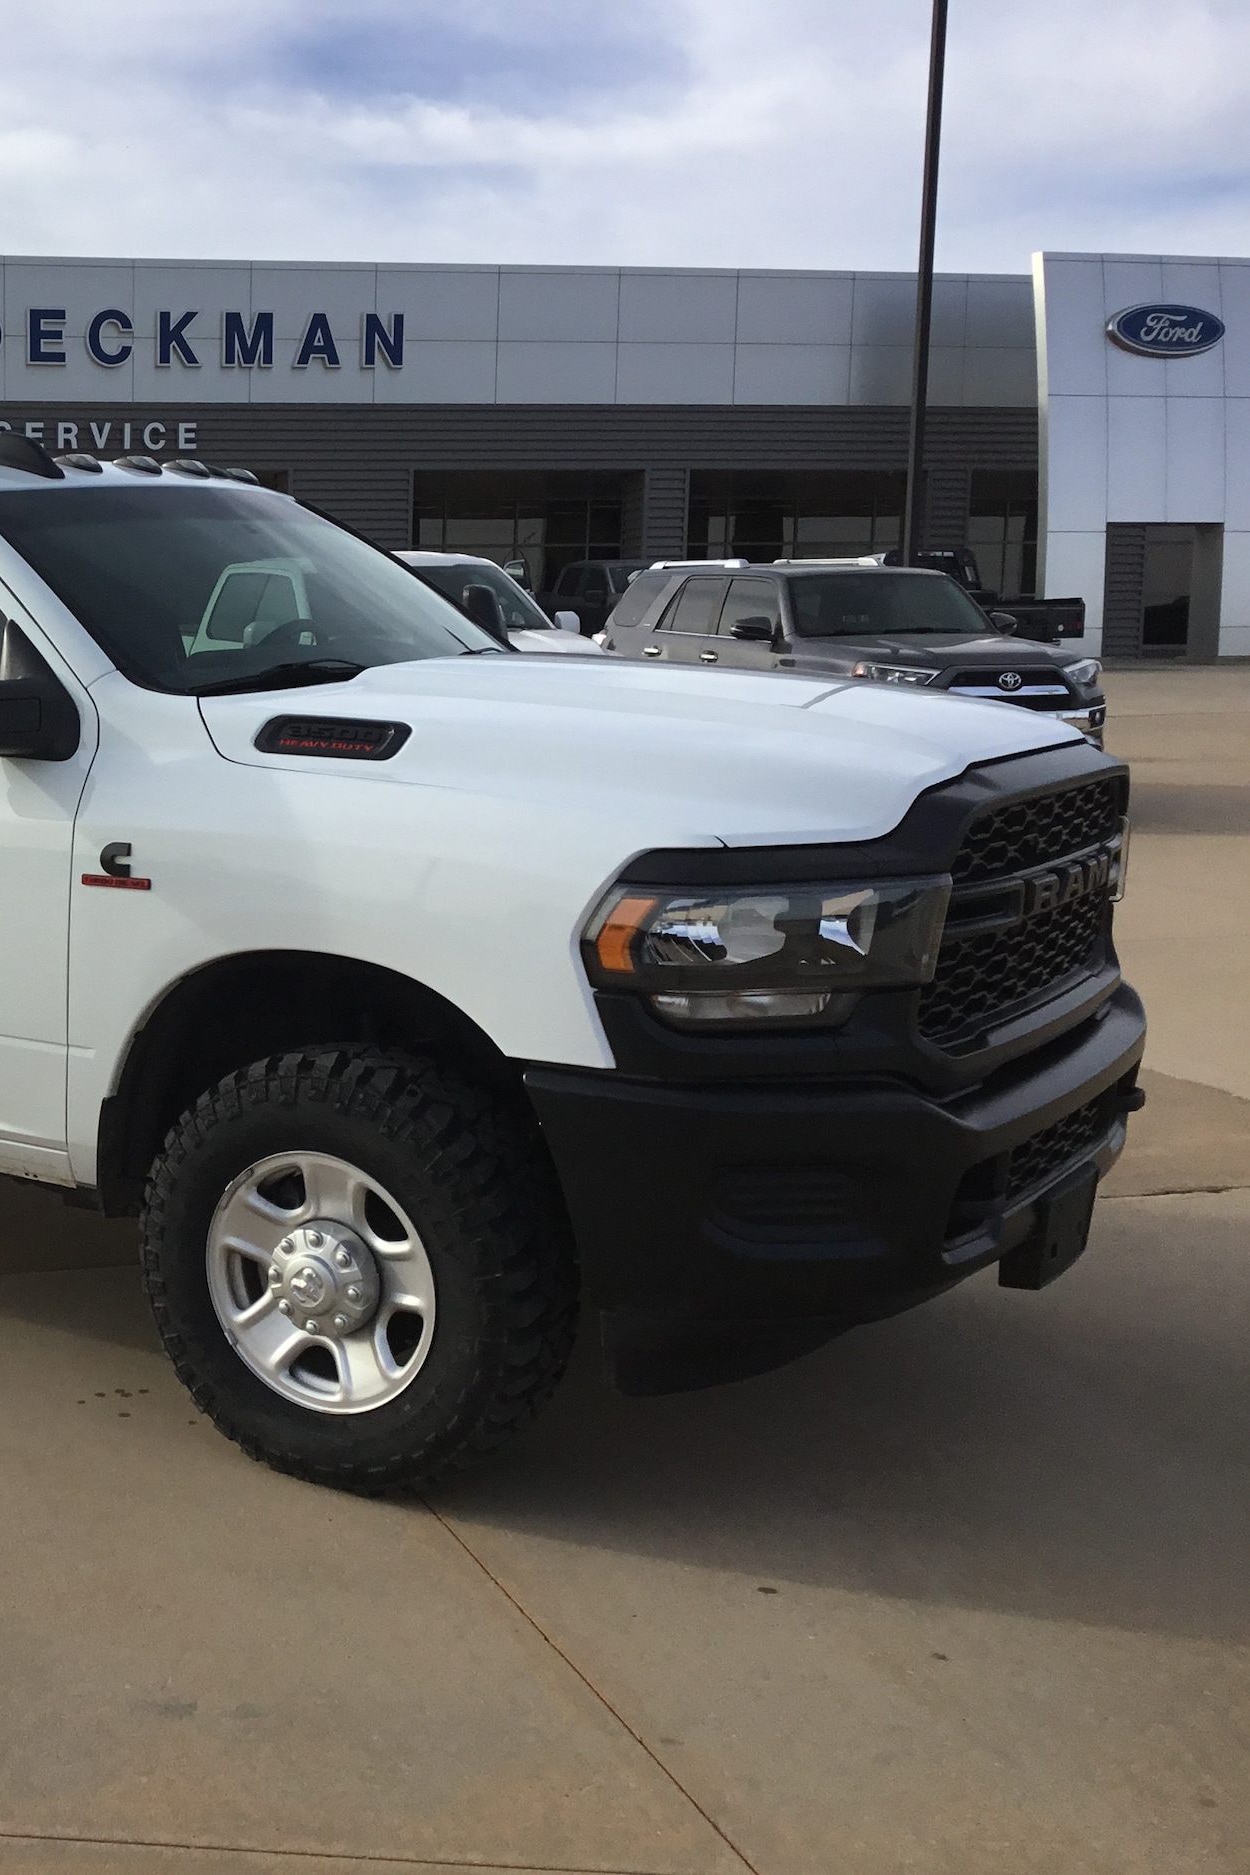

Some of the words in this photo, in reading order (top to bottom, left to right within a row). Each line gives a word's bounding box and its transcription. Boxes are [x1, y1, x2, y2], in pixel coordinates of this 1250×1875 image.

[1140, 313, 1203, 342] Ford
[279, 738, 329, 749] HEAVY
[331, 741, 374, 752] DUTY
[1034, 854, 1108, 915] RAM
